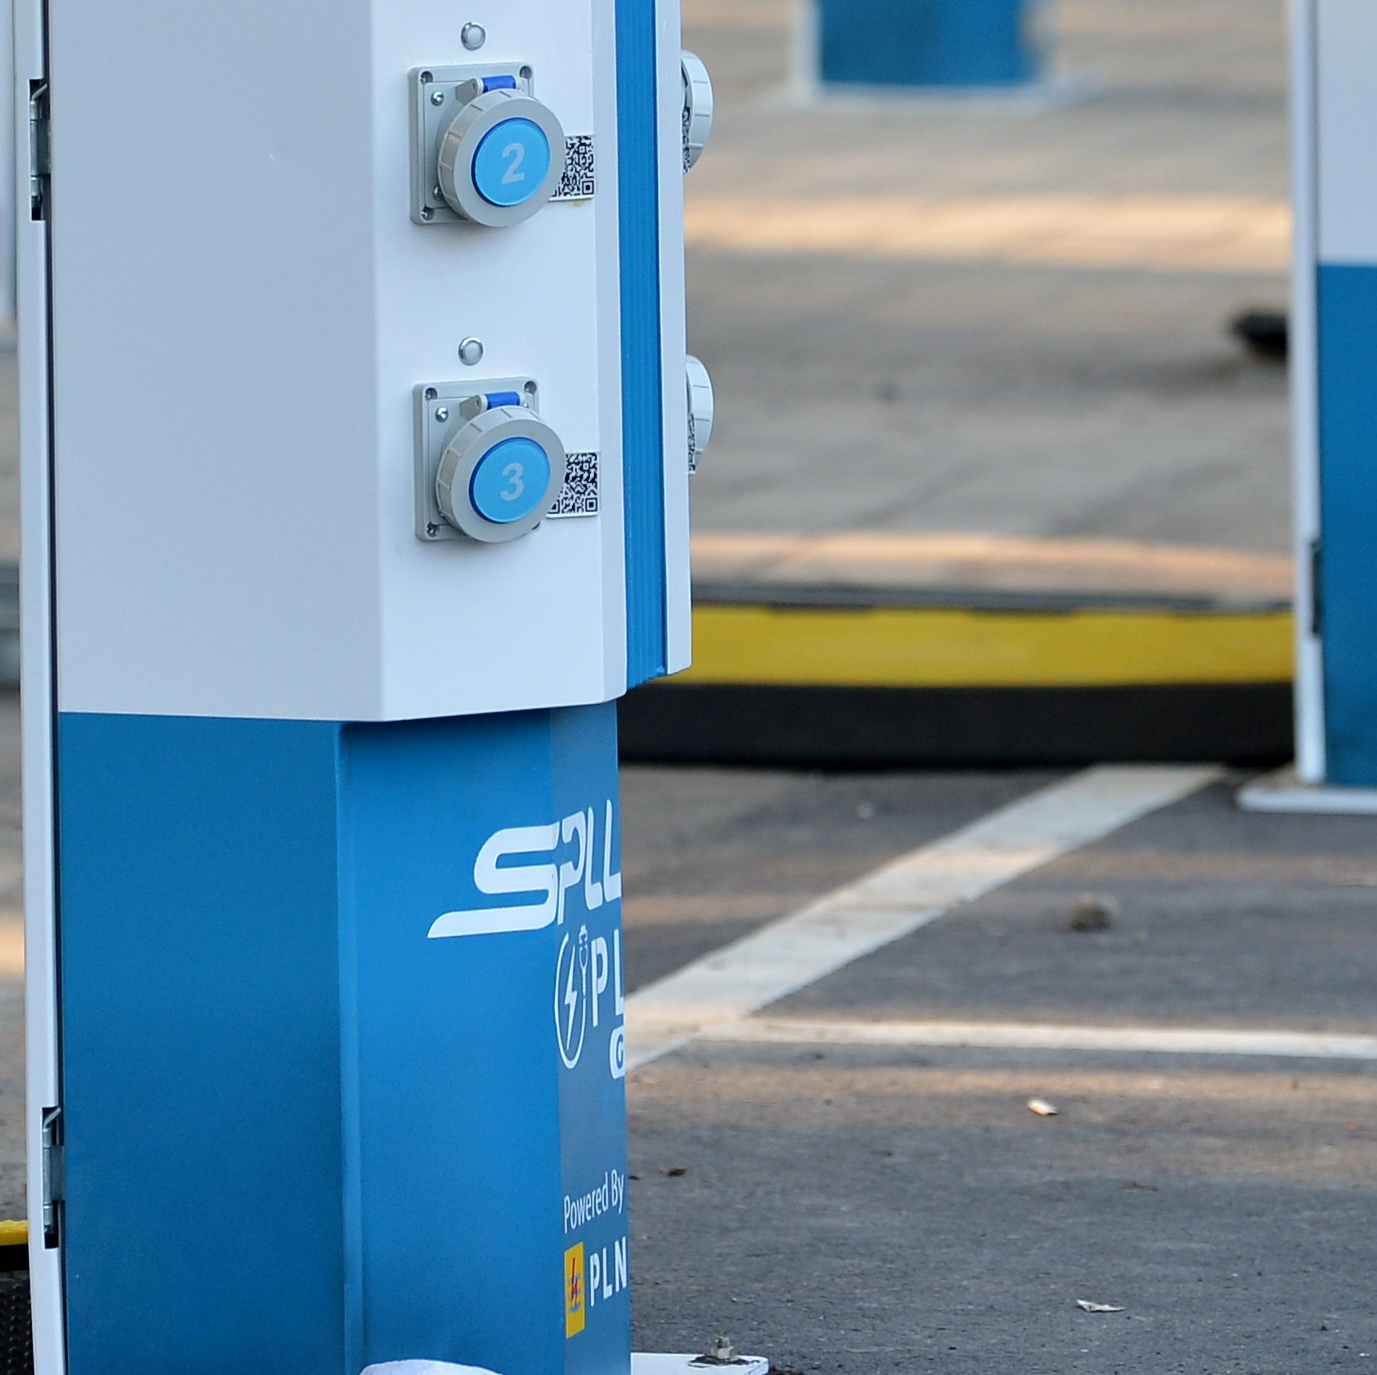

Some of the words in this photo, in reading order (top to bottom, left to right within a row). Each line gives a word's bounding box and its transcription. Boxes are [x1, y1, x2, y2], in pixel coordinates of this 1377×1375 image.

[501, 142, 526, 185] 2
[499, 462, 524, 502] 3
[563, 1171, 609, 1234] Powered
[610, 1168, 625, 1215] By
[589, 1236, 628, 1308] PLN
